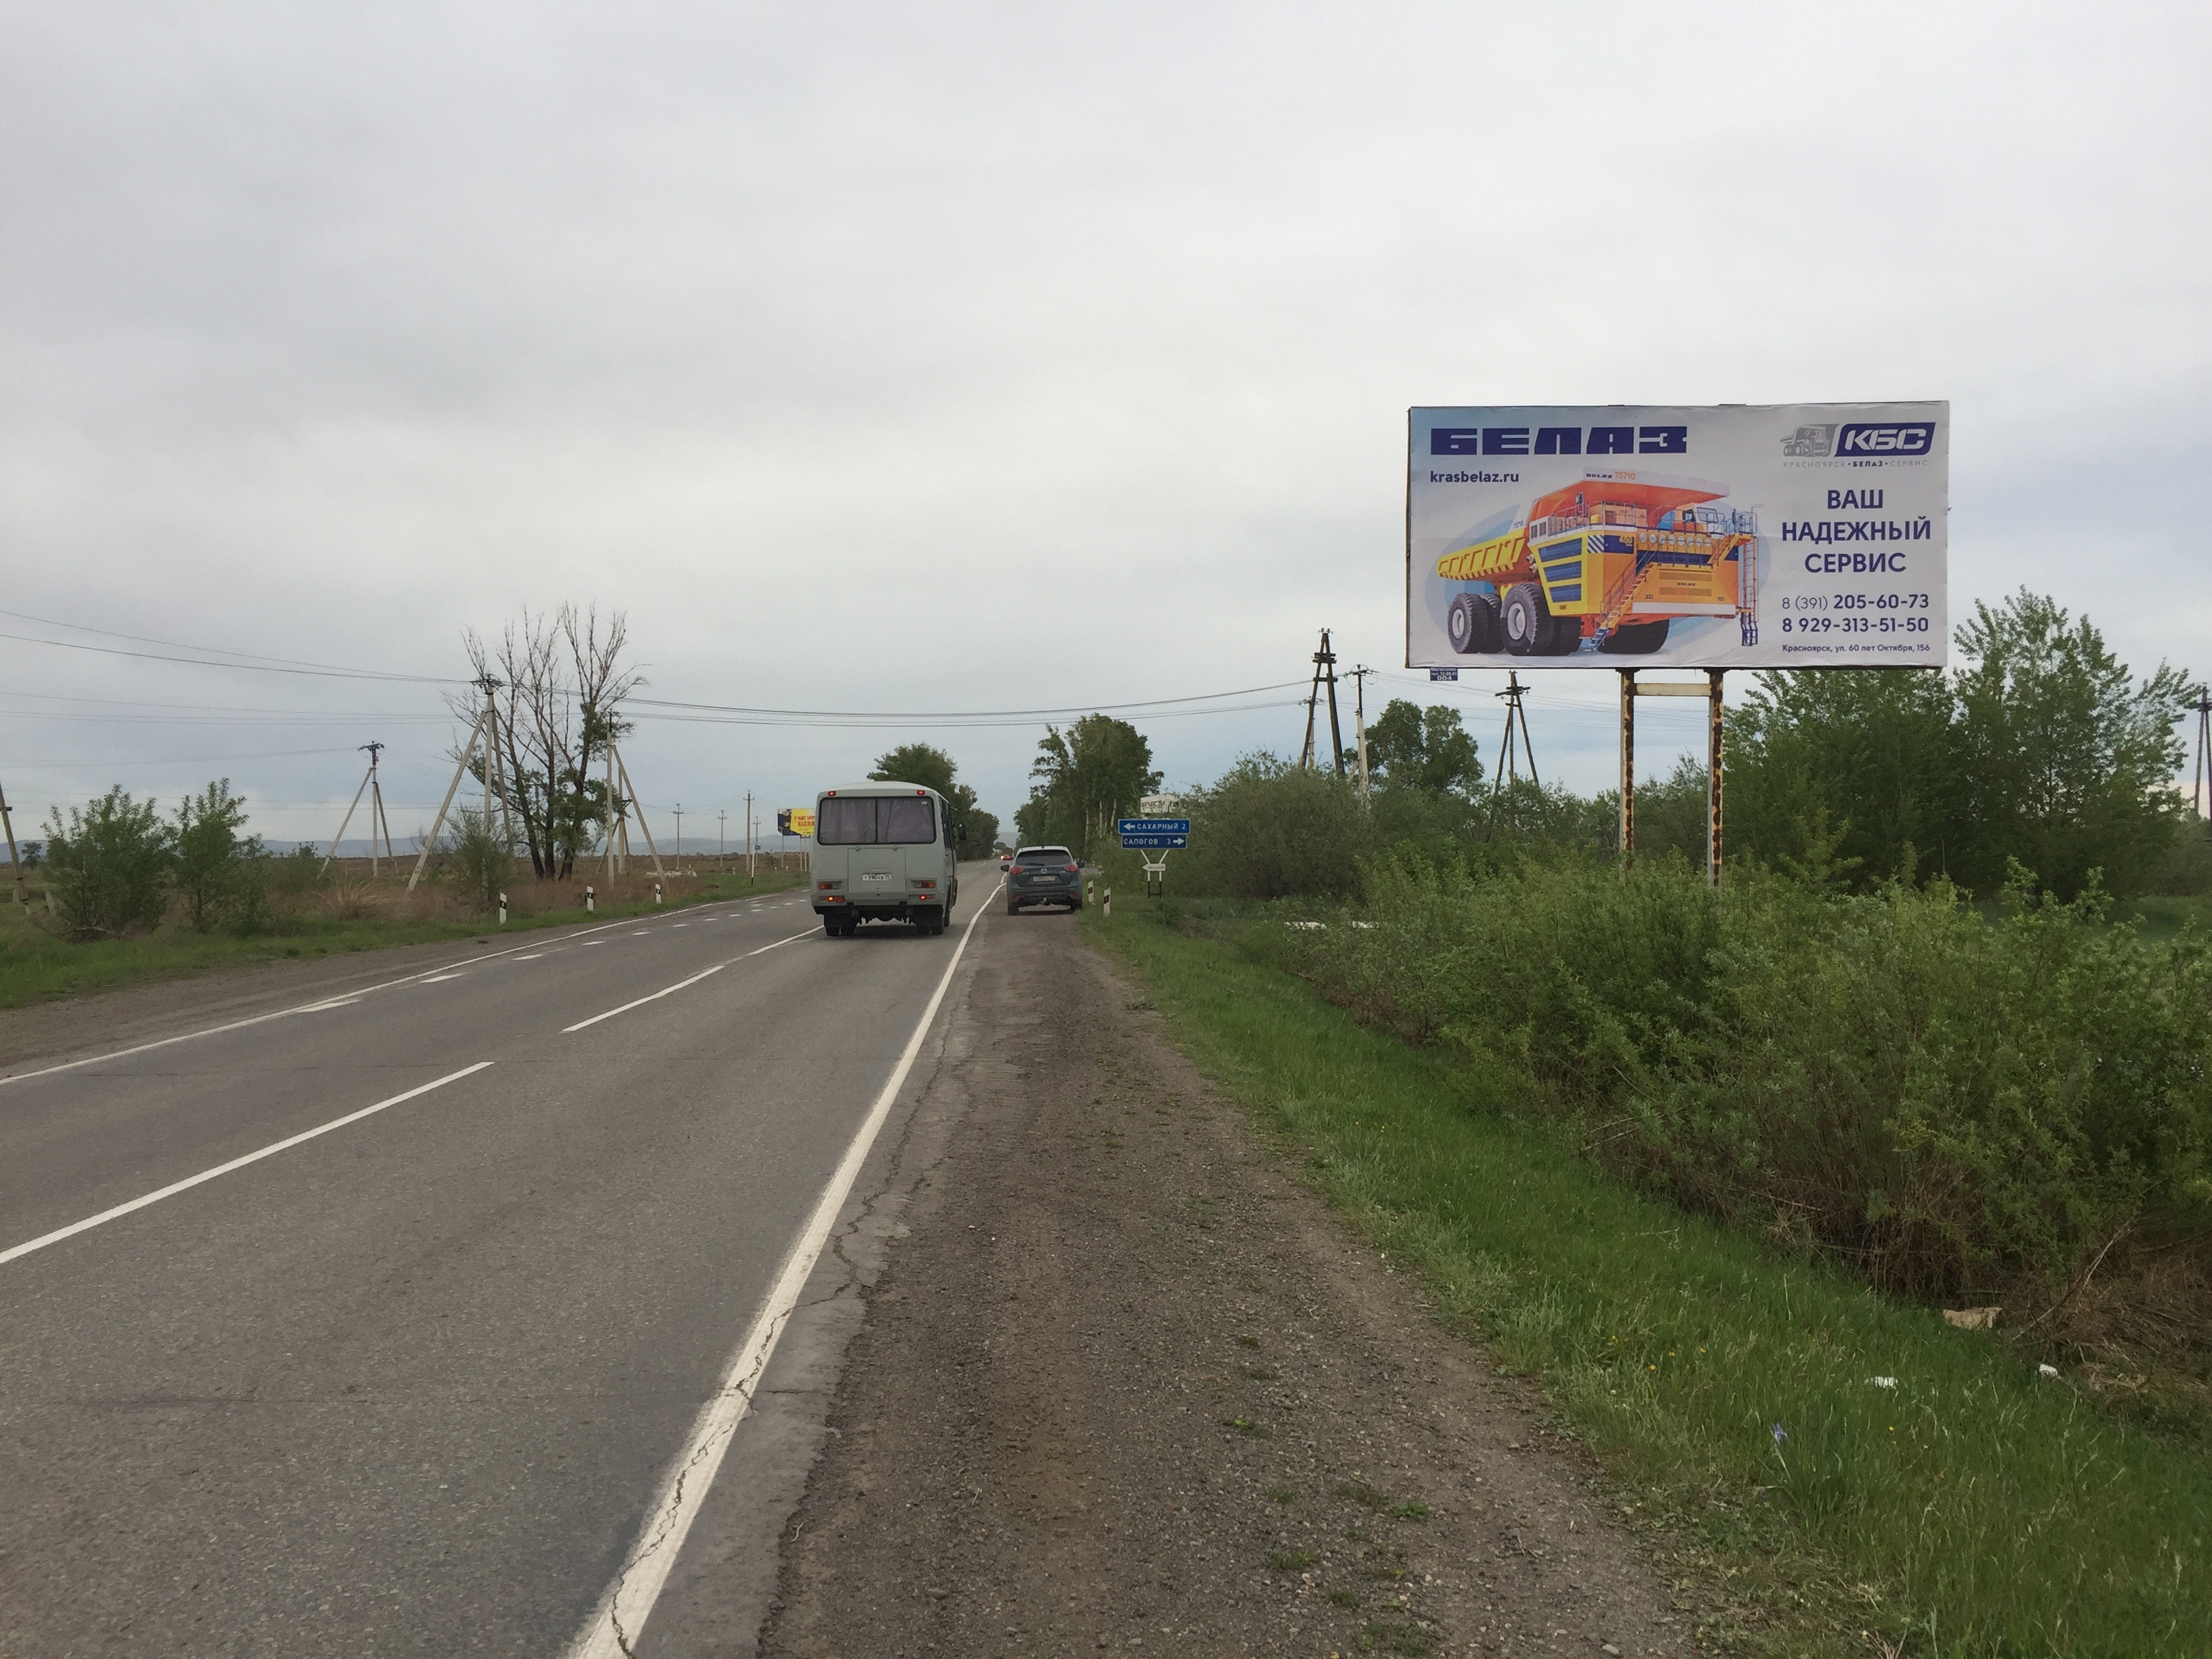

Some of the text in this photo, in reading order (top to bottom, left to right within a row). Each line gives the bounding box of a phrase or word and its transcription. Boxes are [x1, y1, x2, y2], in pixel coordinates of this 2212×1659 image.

[1431, 426, 1687, 455] БЕЛАЗ
[1844, 428, 1927, 451] КБС
[1430, 470, 1519, 483] krasbelaz.ru
[1614, 472, 1635, 480] 75710
[1827, 489, 1883, 509] ВАШ
[1782, 516, 1931, 544] НАДЕЖНЫЙ
[1805, 552, 1906, 573] СЕРВИС
[1782, 594, 1929, 611] 8 (391) 205-60-73
[1782, 617, 1929, 632] 8 929-313-51-50
[1782, 644, 1832, 653] Красноярск,
[1877, 644, 1915, 653] Октября,
[1917, 644, 1930, 652] 156
